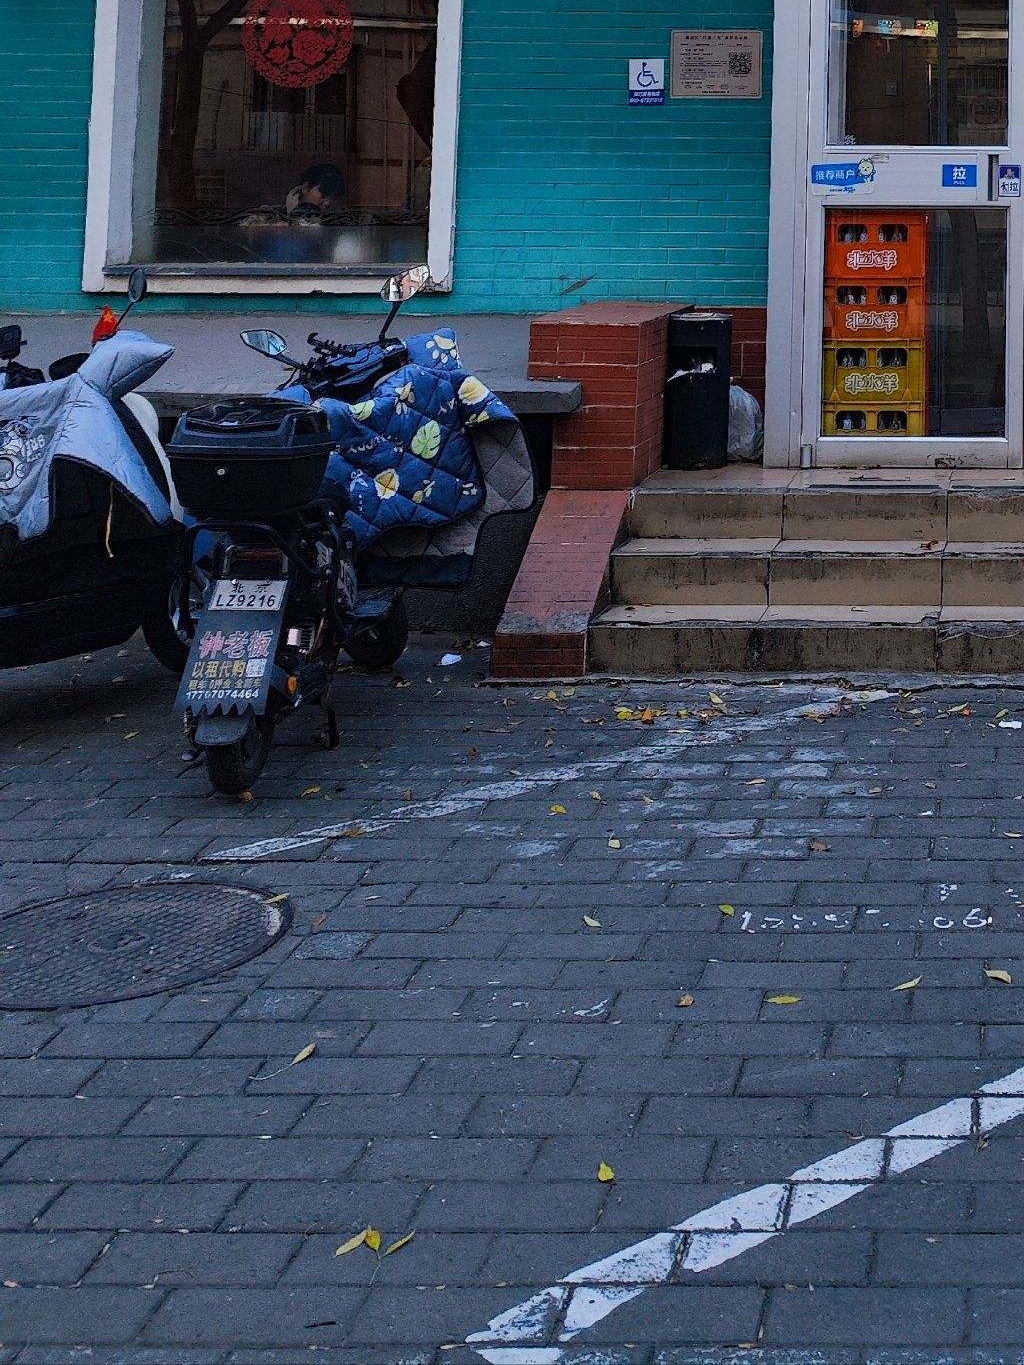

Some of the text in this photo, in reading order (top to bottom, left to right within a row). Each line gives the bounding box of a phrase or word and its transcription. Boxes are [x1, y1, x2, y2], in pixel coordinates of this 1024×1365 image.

[815, 169, 855, 181] 推荐商户
[952, 167, 967, 180] 拉
[847, 250, 898, 270] 北冰洋
[845, 311, 898, 331] 北冰洋
[844, 373, 899, 394] 北冰洋
[216, 594, 277, 607] LZ9216
[198, 629, 274, 660] 钟老板
[191, 660, 247, 679] 以租代购
